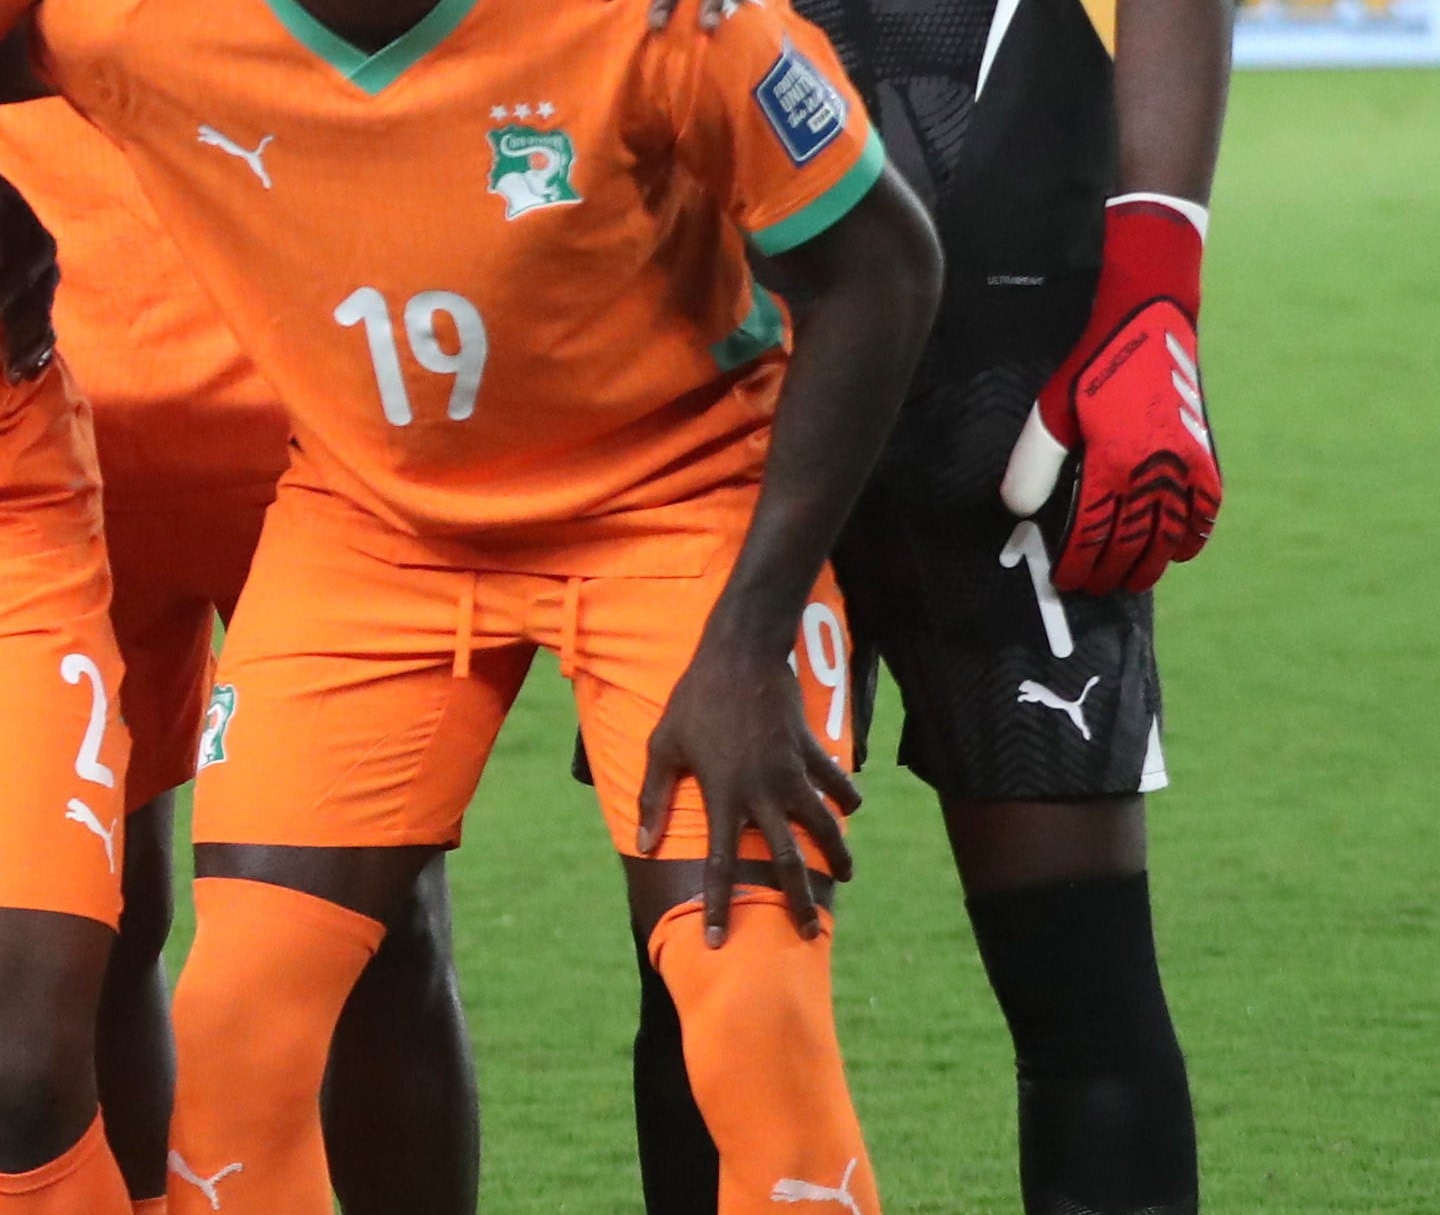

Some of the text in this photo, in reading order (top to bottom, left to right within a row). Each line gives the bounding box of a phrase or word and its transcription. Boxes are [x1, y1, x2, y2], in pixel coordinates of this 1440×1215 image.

[333, 286, 488, 427] 19
[999, 521, 1074, 659] 1
[60, 653, 115, 788] 2
[787, 602, 847, 742] 9
